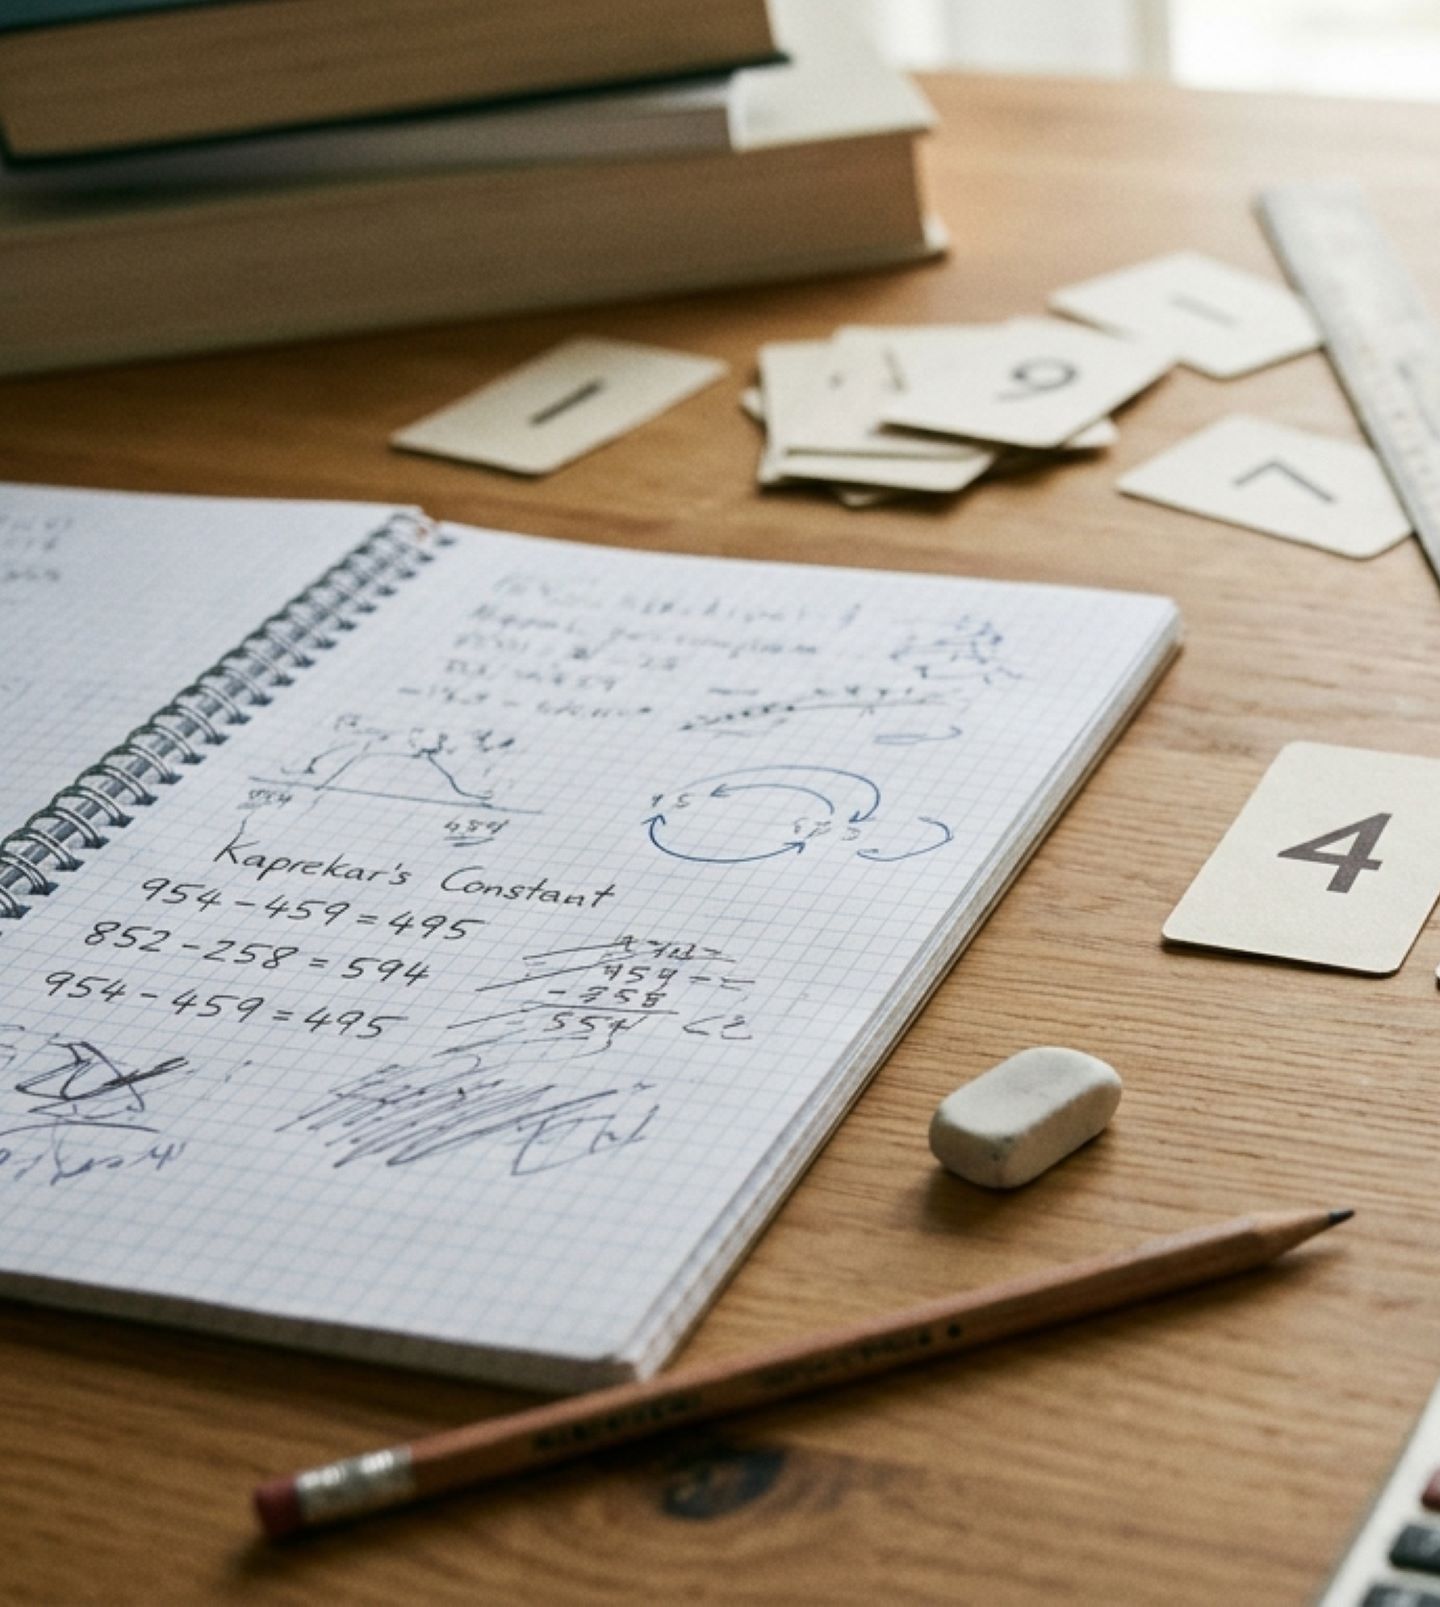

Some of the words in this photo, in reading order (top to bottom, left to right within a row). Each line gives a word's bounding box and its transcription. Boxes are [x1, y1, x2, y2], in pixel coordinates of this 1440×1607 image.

[996, 355, 1082, 402] 9
[213, 840, 412, 886] Kaprekar's
[440, 865, 616, 908] Constant
[1277, 811, 1394, 895] 4
